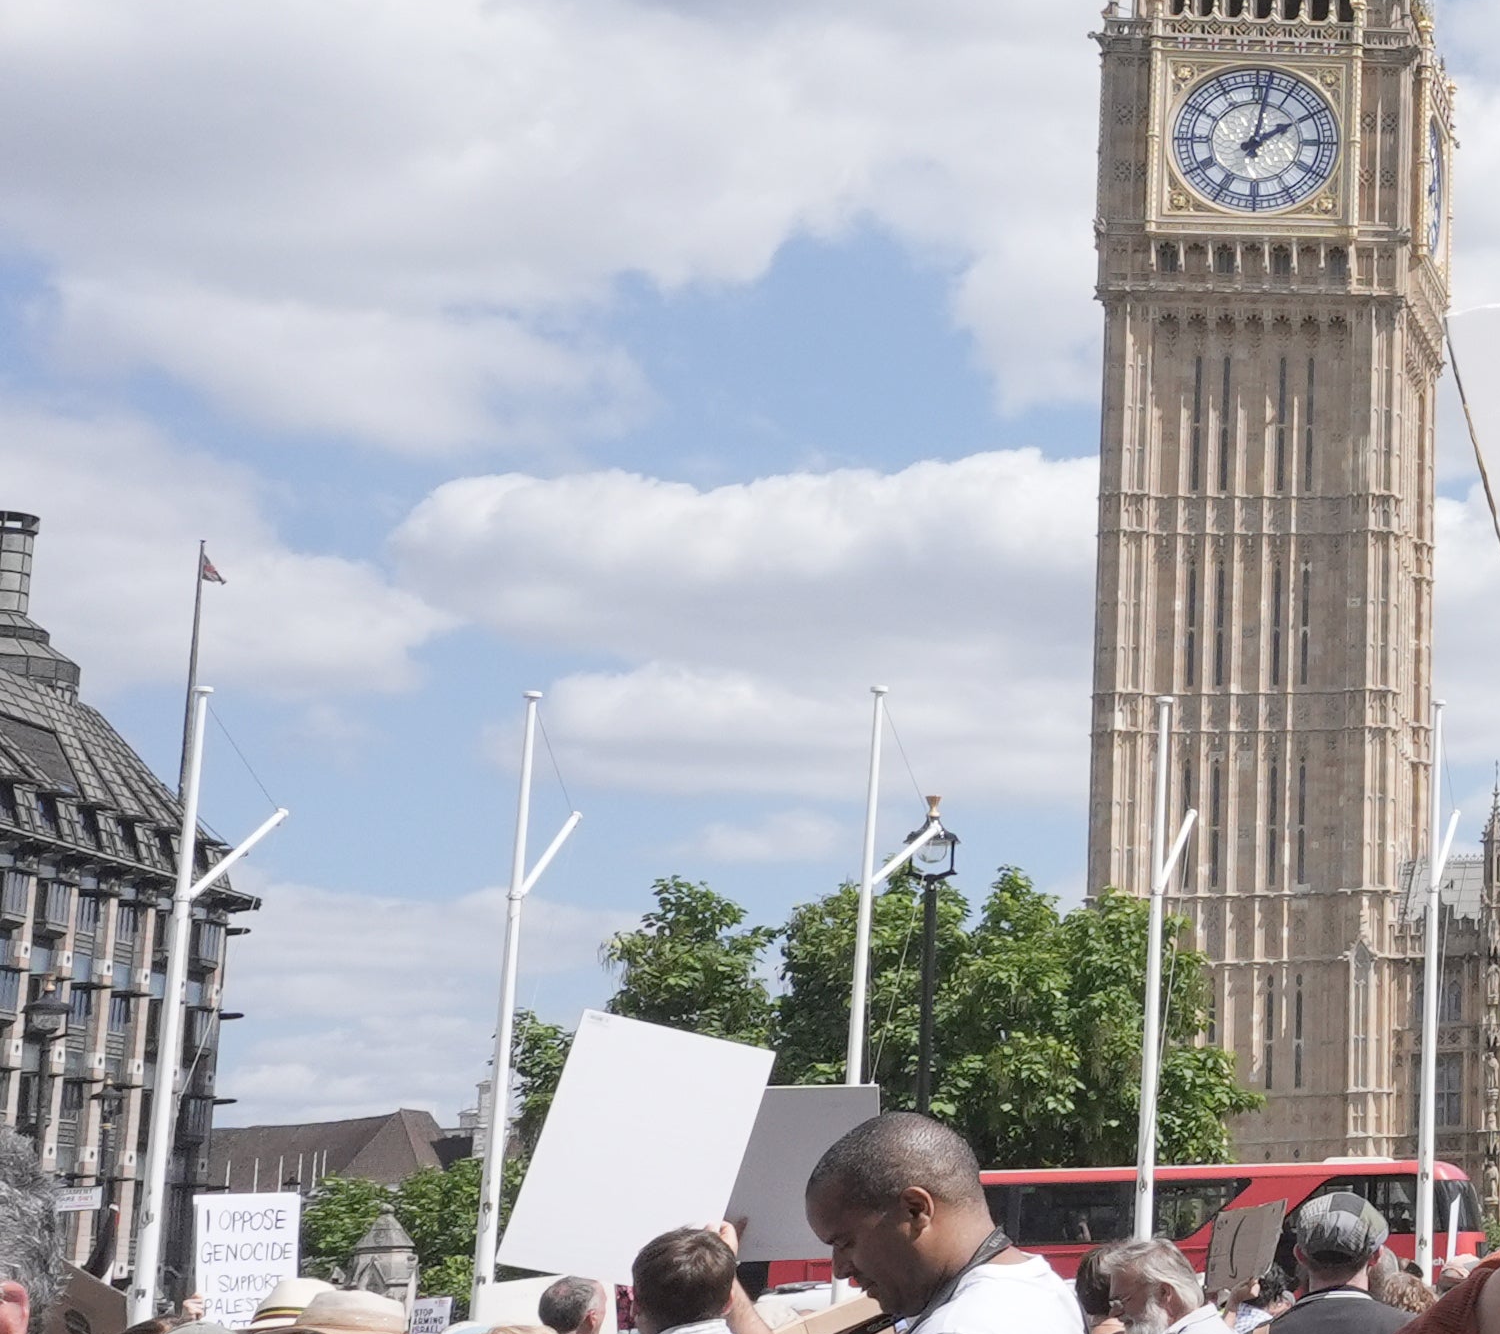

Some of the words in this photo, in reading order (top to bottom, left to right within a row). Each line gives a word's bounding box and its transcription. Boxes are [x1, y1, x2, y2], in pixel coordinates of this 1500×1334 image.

[206, 1209, 210, 1233] I
[219, 1209, 287, 1232] OPPOSE
[200, 1242, 293, 1264] GENOCIDE
[205, 1275, 208, 1292] I
[218, 1273, 283, 1293] SUPPORT
